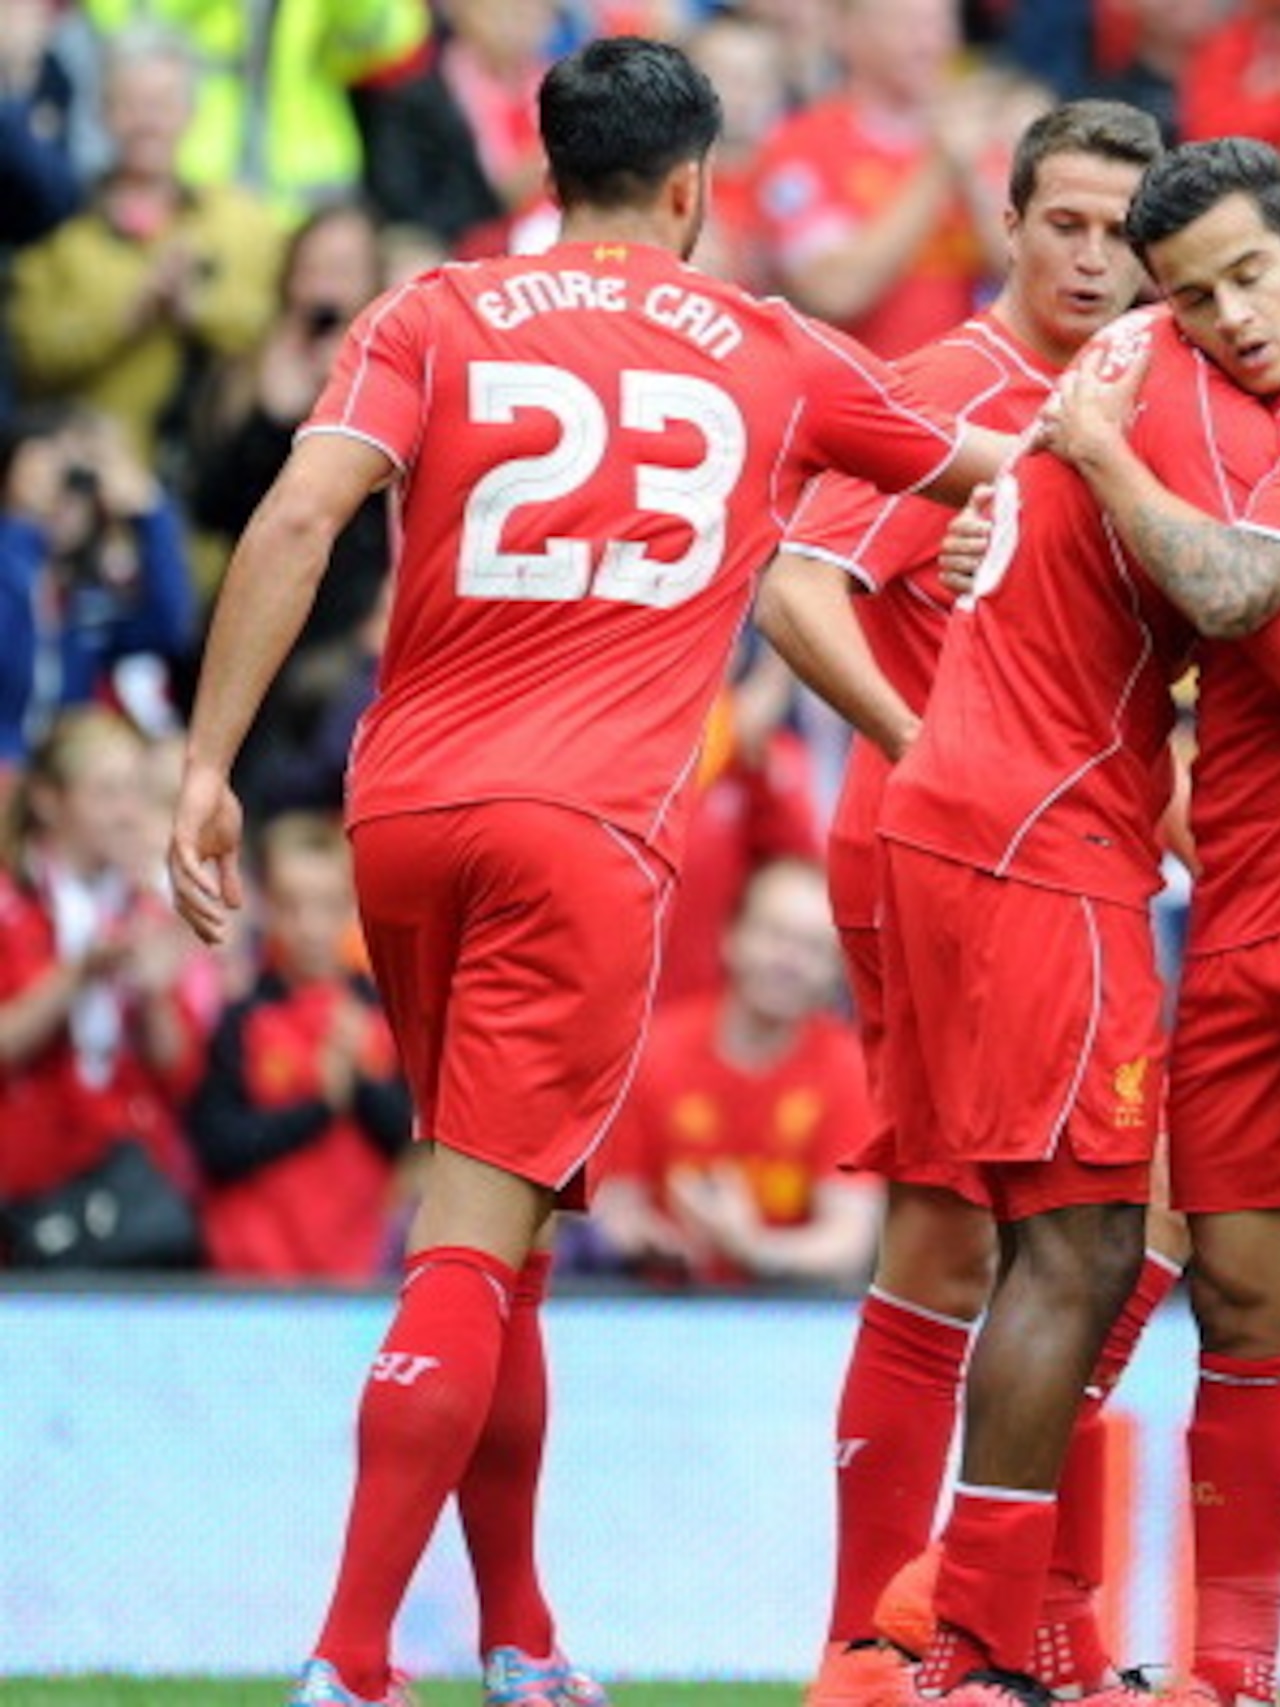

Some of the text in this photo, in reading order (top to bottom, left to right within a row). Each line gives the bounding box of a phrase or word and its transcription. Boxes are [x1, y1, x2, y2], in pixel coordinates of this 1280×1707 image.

[476, 270, 743, 360] EMRE CAN
[457, 360, 748, 610] 23
